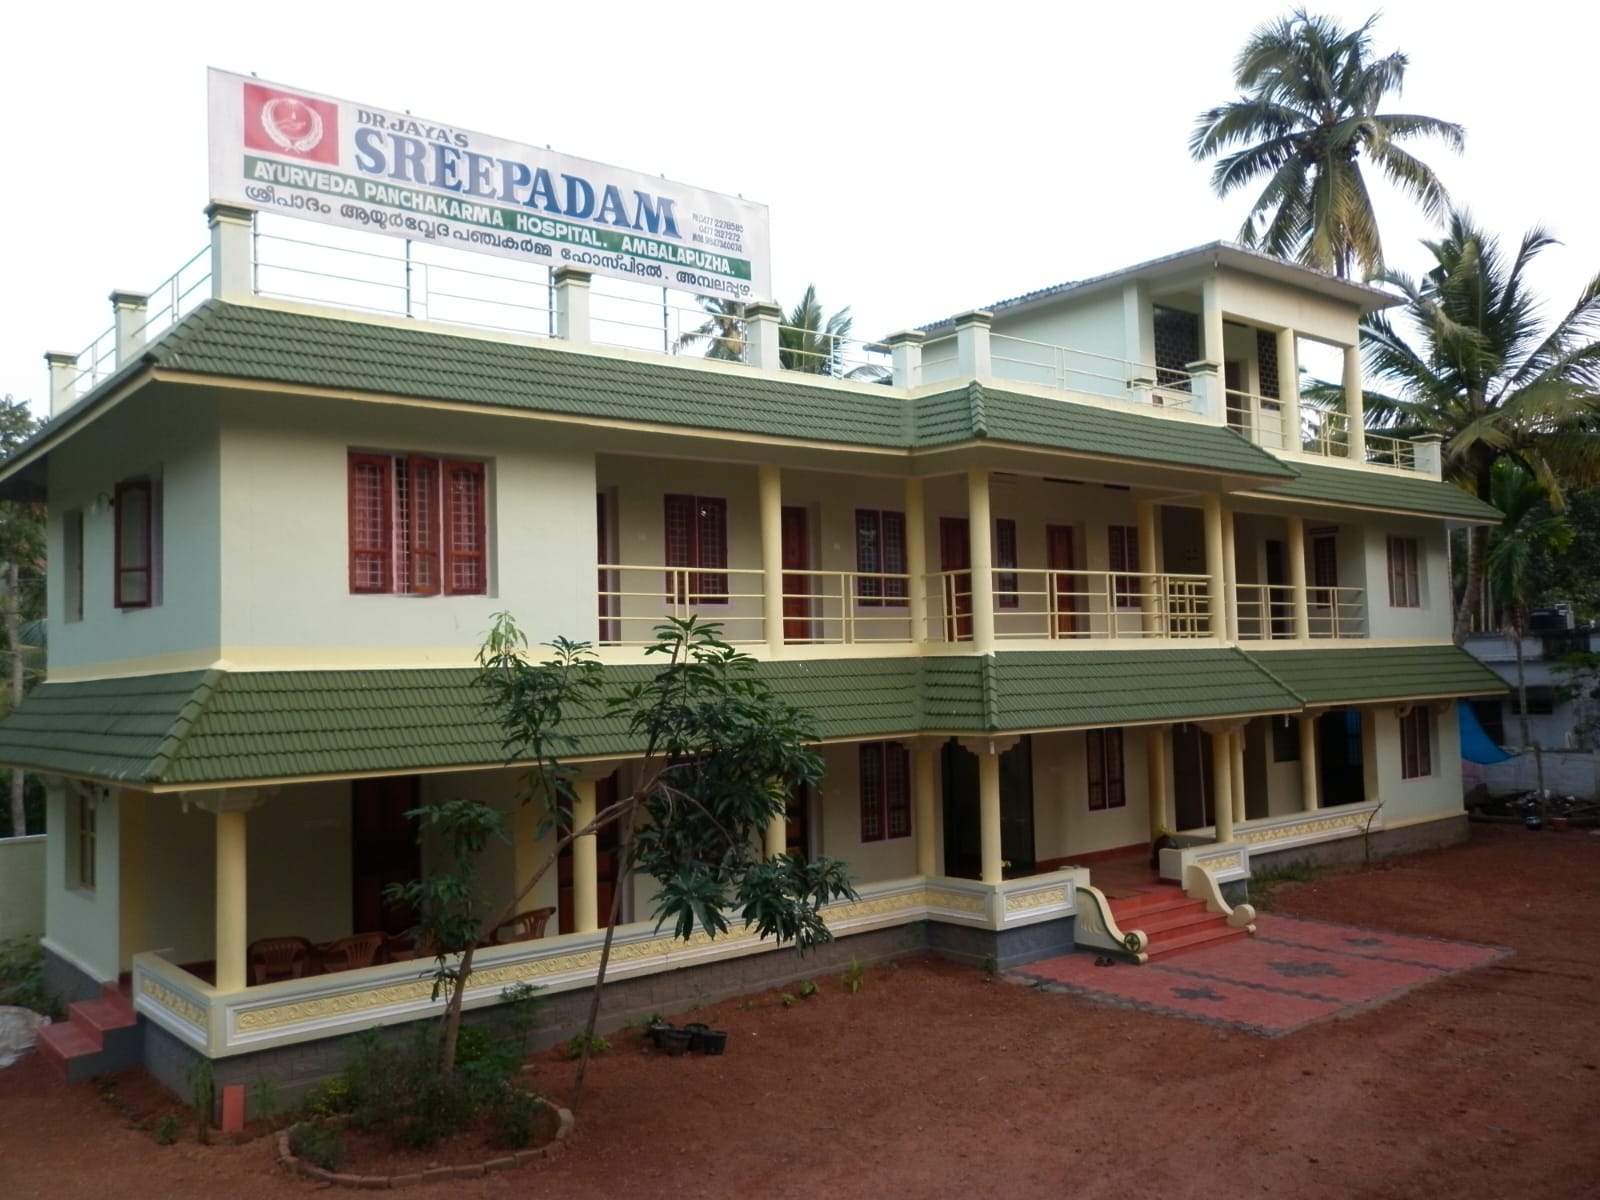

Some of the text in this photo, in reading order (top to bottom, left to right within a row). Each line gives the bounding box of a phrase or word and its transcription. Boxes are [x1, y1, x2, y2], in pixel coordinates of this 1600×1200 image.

[245, 185, 332, 214] ശ്രീപാദം
[254, 160, 735, 276] AYURVEDA PANCHAKARMA HOSPITAL. AMBALAPUZHA.
[354, 127, 682, 239] SREEPADAM
